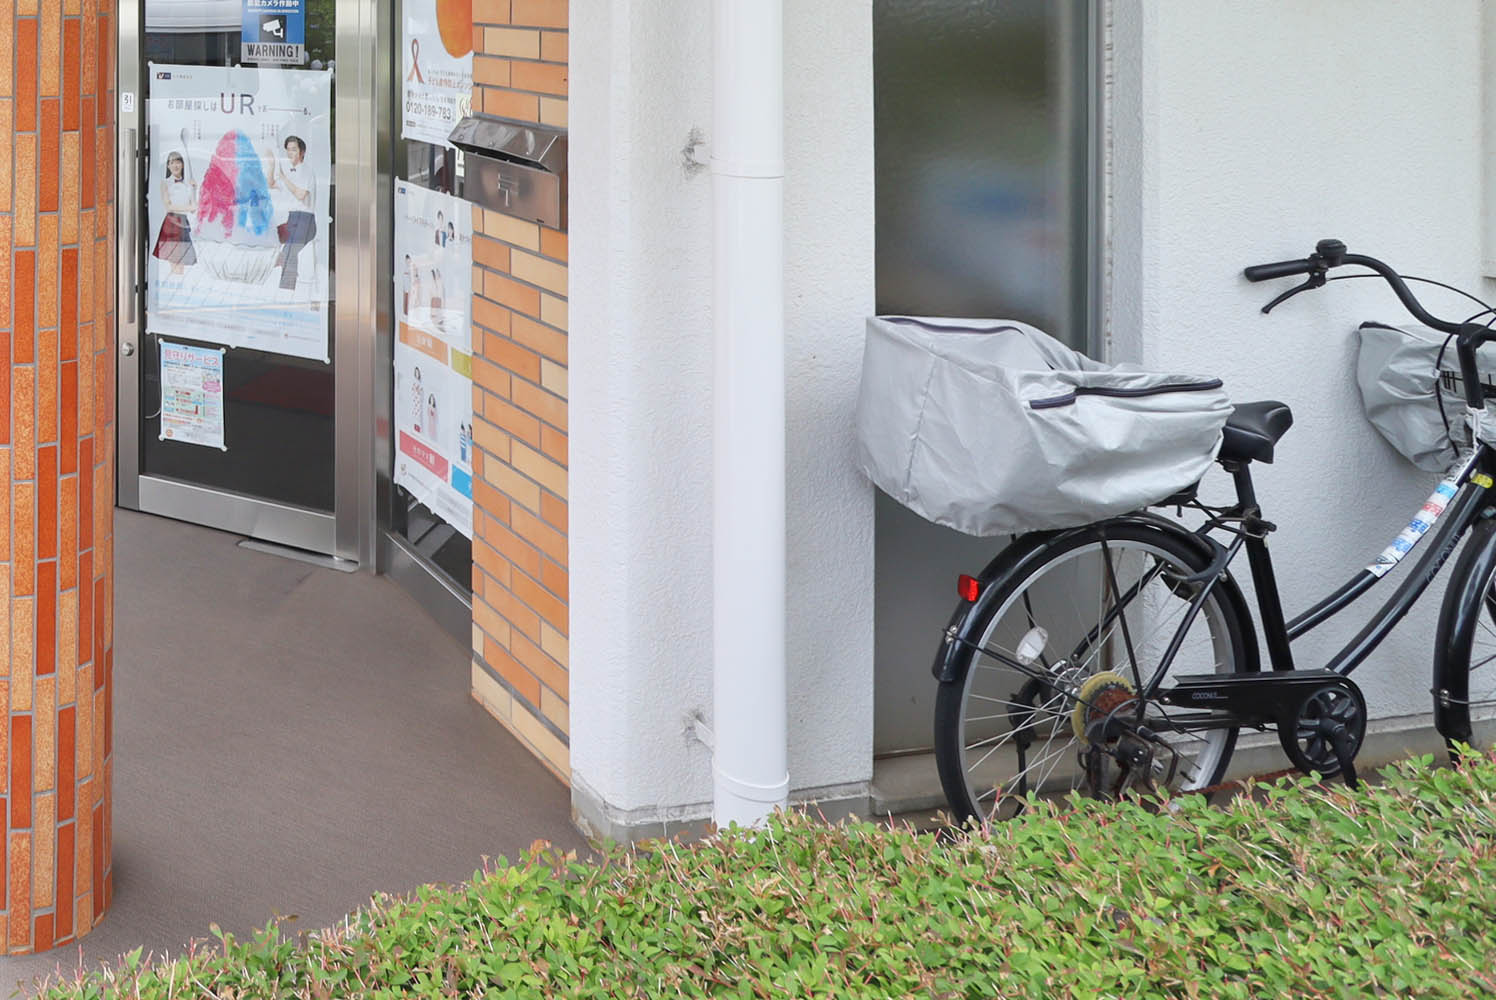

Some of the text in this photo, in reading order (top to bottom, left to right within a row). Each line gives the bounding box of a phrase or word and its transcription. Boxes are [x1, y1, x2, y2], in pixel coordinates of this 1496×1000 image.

[248, 44, 299, 58] WARNING!
[220, 92, 255, 115] UR
[406, 101, 452, 120] 0120-189-783
